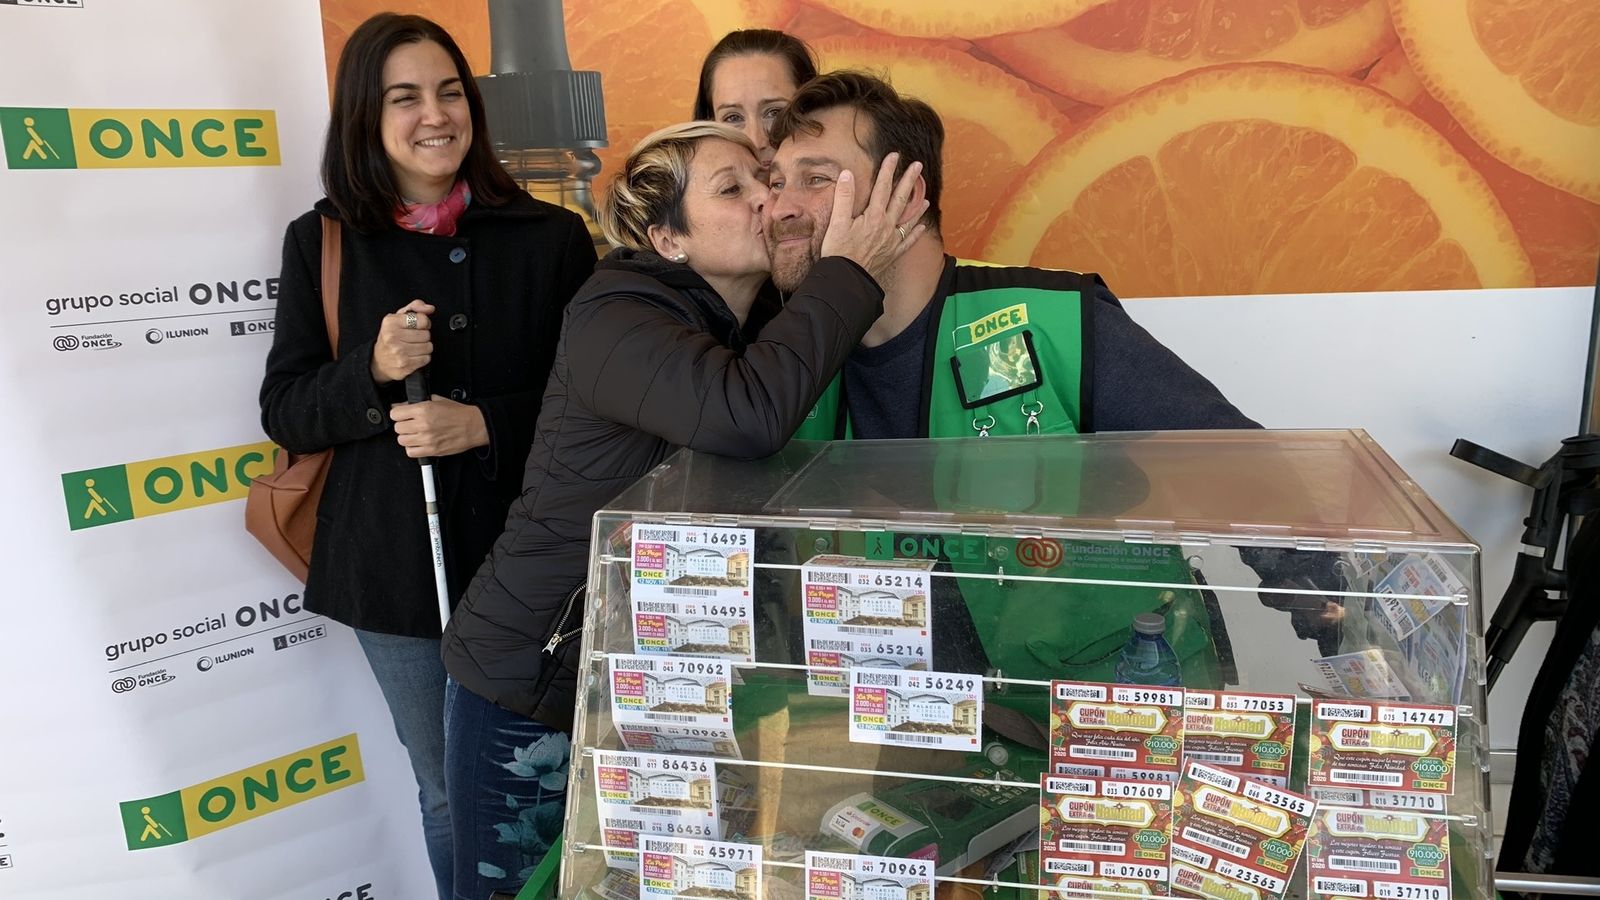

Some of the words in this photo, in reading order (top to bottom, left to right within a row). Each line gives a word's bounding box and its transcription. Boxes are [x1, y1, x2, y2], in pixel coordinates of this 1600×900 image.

[89, 118, 268, 159] ONCE
[46, 293, 114, 316] grupo
[119, 286, 179, 306] social
[189, 278, 280, 305] ONCE
[248, 321, 276, 332] ONC
[975, 309, 1022, 338] ONCE
[166, 328, 209, 339] ILUNION
[82, 339, 114, 348] ONCE
[144, 448, 280, 504] ONC
[703, 532, 747, 545] 16495
[900, 537, 979, 559] ONCE
[1065, 544, 1128, 556] Fundación
[1132, 547, 1170, 557] ONCE
[875, 575, 923, 588] 65214
[702, 605, 746, 617] 16495
[105, 632, 168, 661] grupo
[172, 613, 227, 641] social
[235, 594, 302, 627] ONC
[290, 627, 324, 644] ONCE
[215, 648, 255, 664] ILUNION
[877, 644, 924, 656] 65214
[138, 669, 167, 679] Fundación
[679, 662, 723, 675] 70962
[139, 674, 168, 687] ONCE
[926, 678, 974, 692] 56249
[1134, 692, 1174, 704] 59981
[1244, 700, 1284, 711] 77053
[1080, 707, 1105, 718] CUPÓN
[1402, 712, 1444, 724] 14747
[1080, 717, 1097, 725] EXTRA
[683, 729, 728, 738] 70962
[1342, 728, 1369, 738] CUPÓN
[1146, 740, 1178, 749] 910.000
[1342, 738, 1360, 746] EXTRA
[1254, 746, 1286, 755] 910.000
[663, 760, 707, 772] 86436
[1414, 764, 1448, 772] 910.000
[1132, 772, 1170, 781] 59981
[198, 745, 351, 822] ONCE
[1123, 786, 1163, 798] 07609
[1069, 801, 1094, 811] CUPÓN
[1206, 793, 1232, 808] CUPÓN
[1264, 792, 1305, 813] 23565
[1393, 795, 1435, 808] 37710
[1203, 803, 1221, 813] EXTRA
[871, 808, 899, 826] ONCE
[667, 824, 711, 836] 86436
[1136, 834, 1166, 844] 910.000
[709, 847, 753, 861] 45971
[1262, 842, 1294, 857] 910.000
[1409, 850, 1444, 859] 910.000
[880, 862, 927, 876] 70962
[1121, 866, 1160, 878] 07609
[1265, 862, 1286, 872] ONCE
[1236, 869, 1276, 889] 23565
[1397, 887, 1440, 900] 37710
